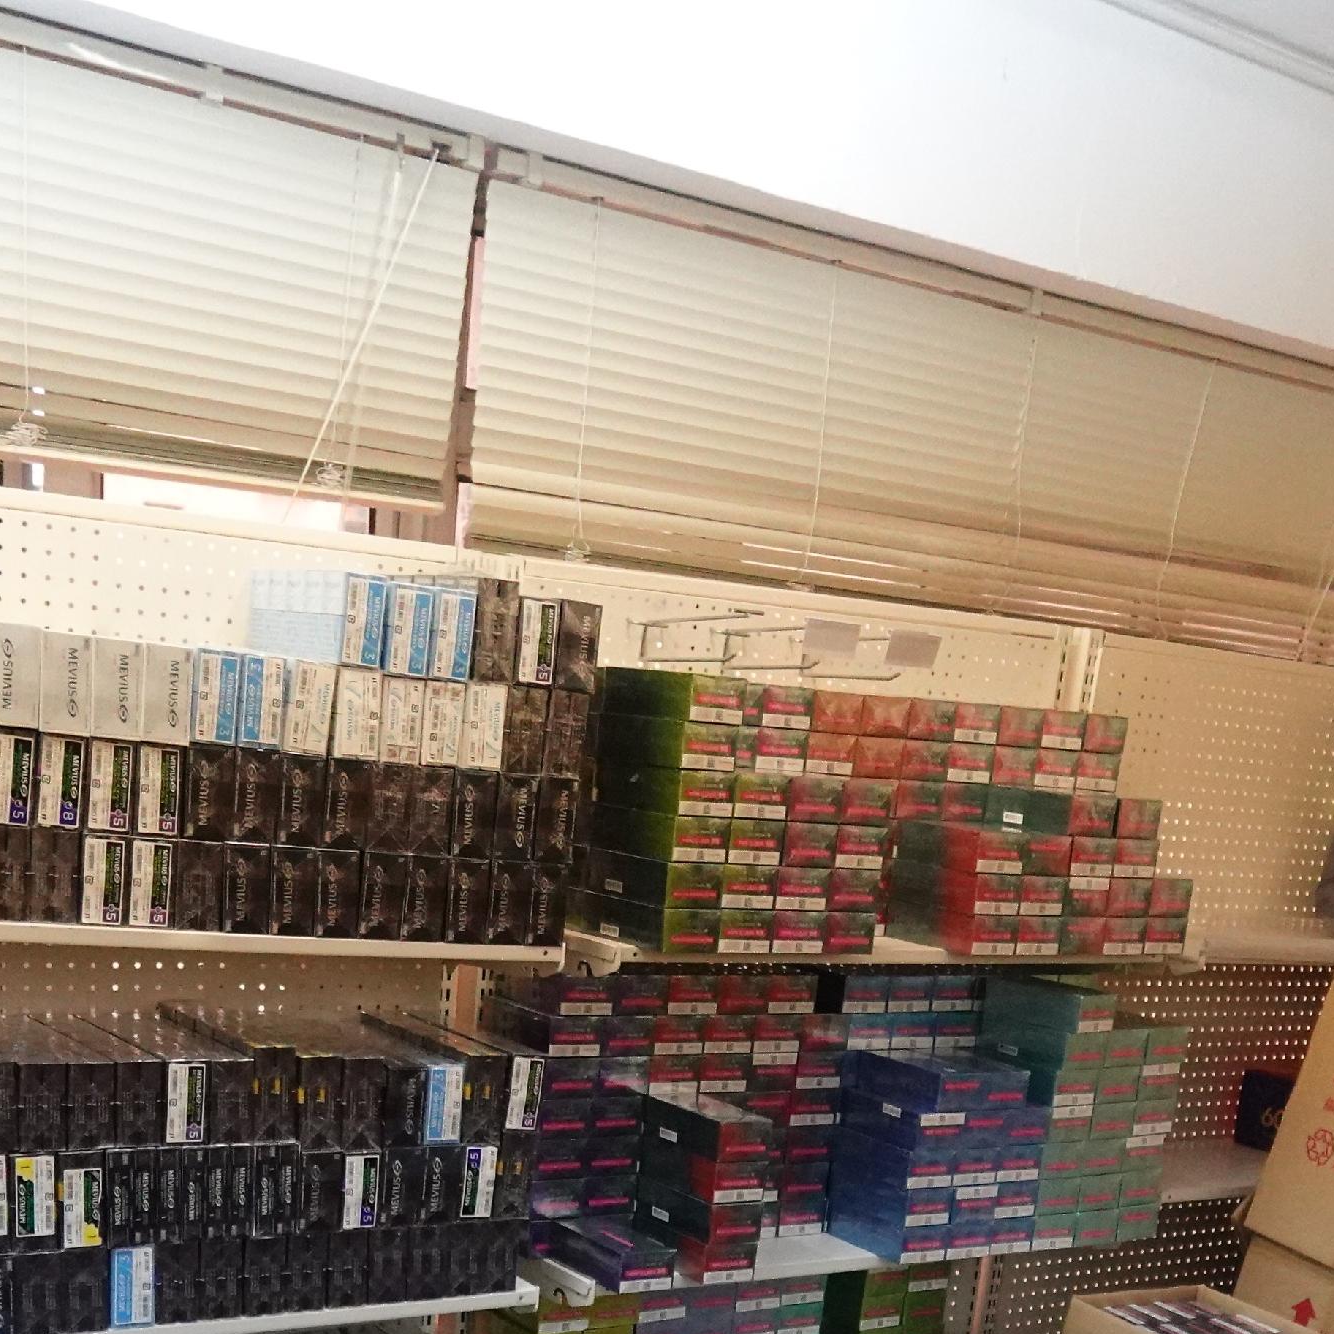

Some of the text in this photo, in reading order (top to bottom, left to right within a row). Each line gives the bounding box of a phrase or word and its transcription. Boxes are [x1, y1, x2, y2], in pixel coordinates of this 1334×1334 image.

[2, 660, 13, 710] MEVIUS
[67, 648, 79, 702] MEVIUS
[119, 655, 129, 705] MEVIUS
[169, 660, 179, 710] MEVIUS
[12, 753, 30, 820] MEVIUS 5
[63, 755, 81, 821] MEVIUS 8
[198, 780, 209, 826] MEVIUS
[113, 818, 124, 828] 5
[162, 821, 173, 830] 5
[291, 788, 303, 833] MEVIUS
[463, 801, 474, 845] MEVIUS
[516, 787, 528, 831] MEVIUS
[105, 846, 122, 921] MEVIUS 5
[235, 878, 247, 921] MEVIUS
[283, 881, 294, 924] MEVIUS
[327, 883, 338, 926] MEVIUS
[153, 914, 164, 923] 5
[458, 891, 468, 932] MEVIUS
[498, 891, 508, 932] MEVIUS
[537, 893, 548, 935] MEVIUS
[189, 1131, 199, 1139] 5
[470, 1152, 479, 1160] 5
[142, 1172, 150, 1200] MEVIUS
[390, 1176, 402, 1216] MEVIUS
[430, 1175, 443, 1213] MEVIUS
[19, 1195, 27, 1224] MEVIUS
[363, 1214, 373, 1222] 5
